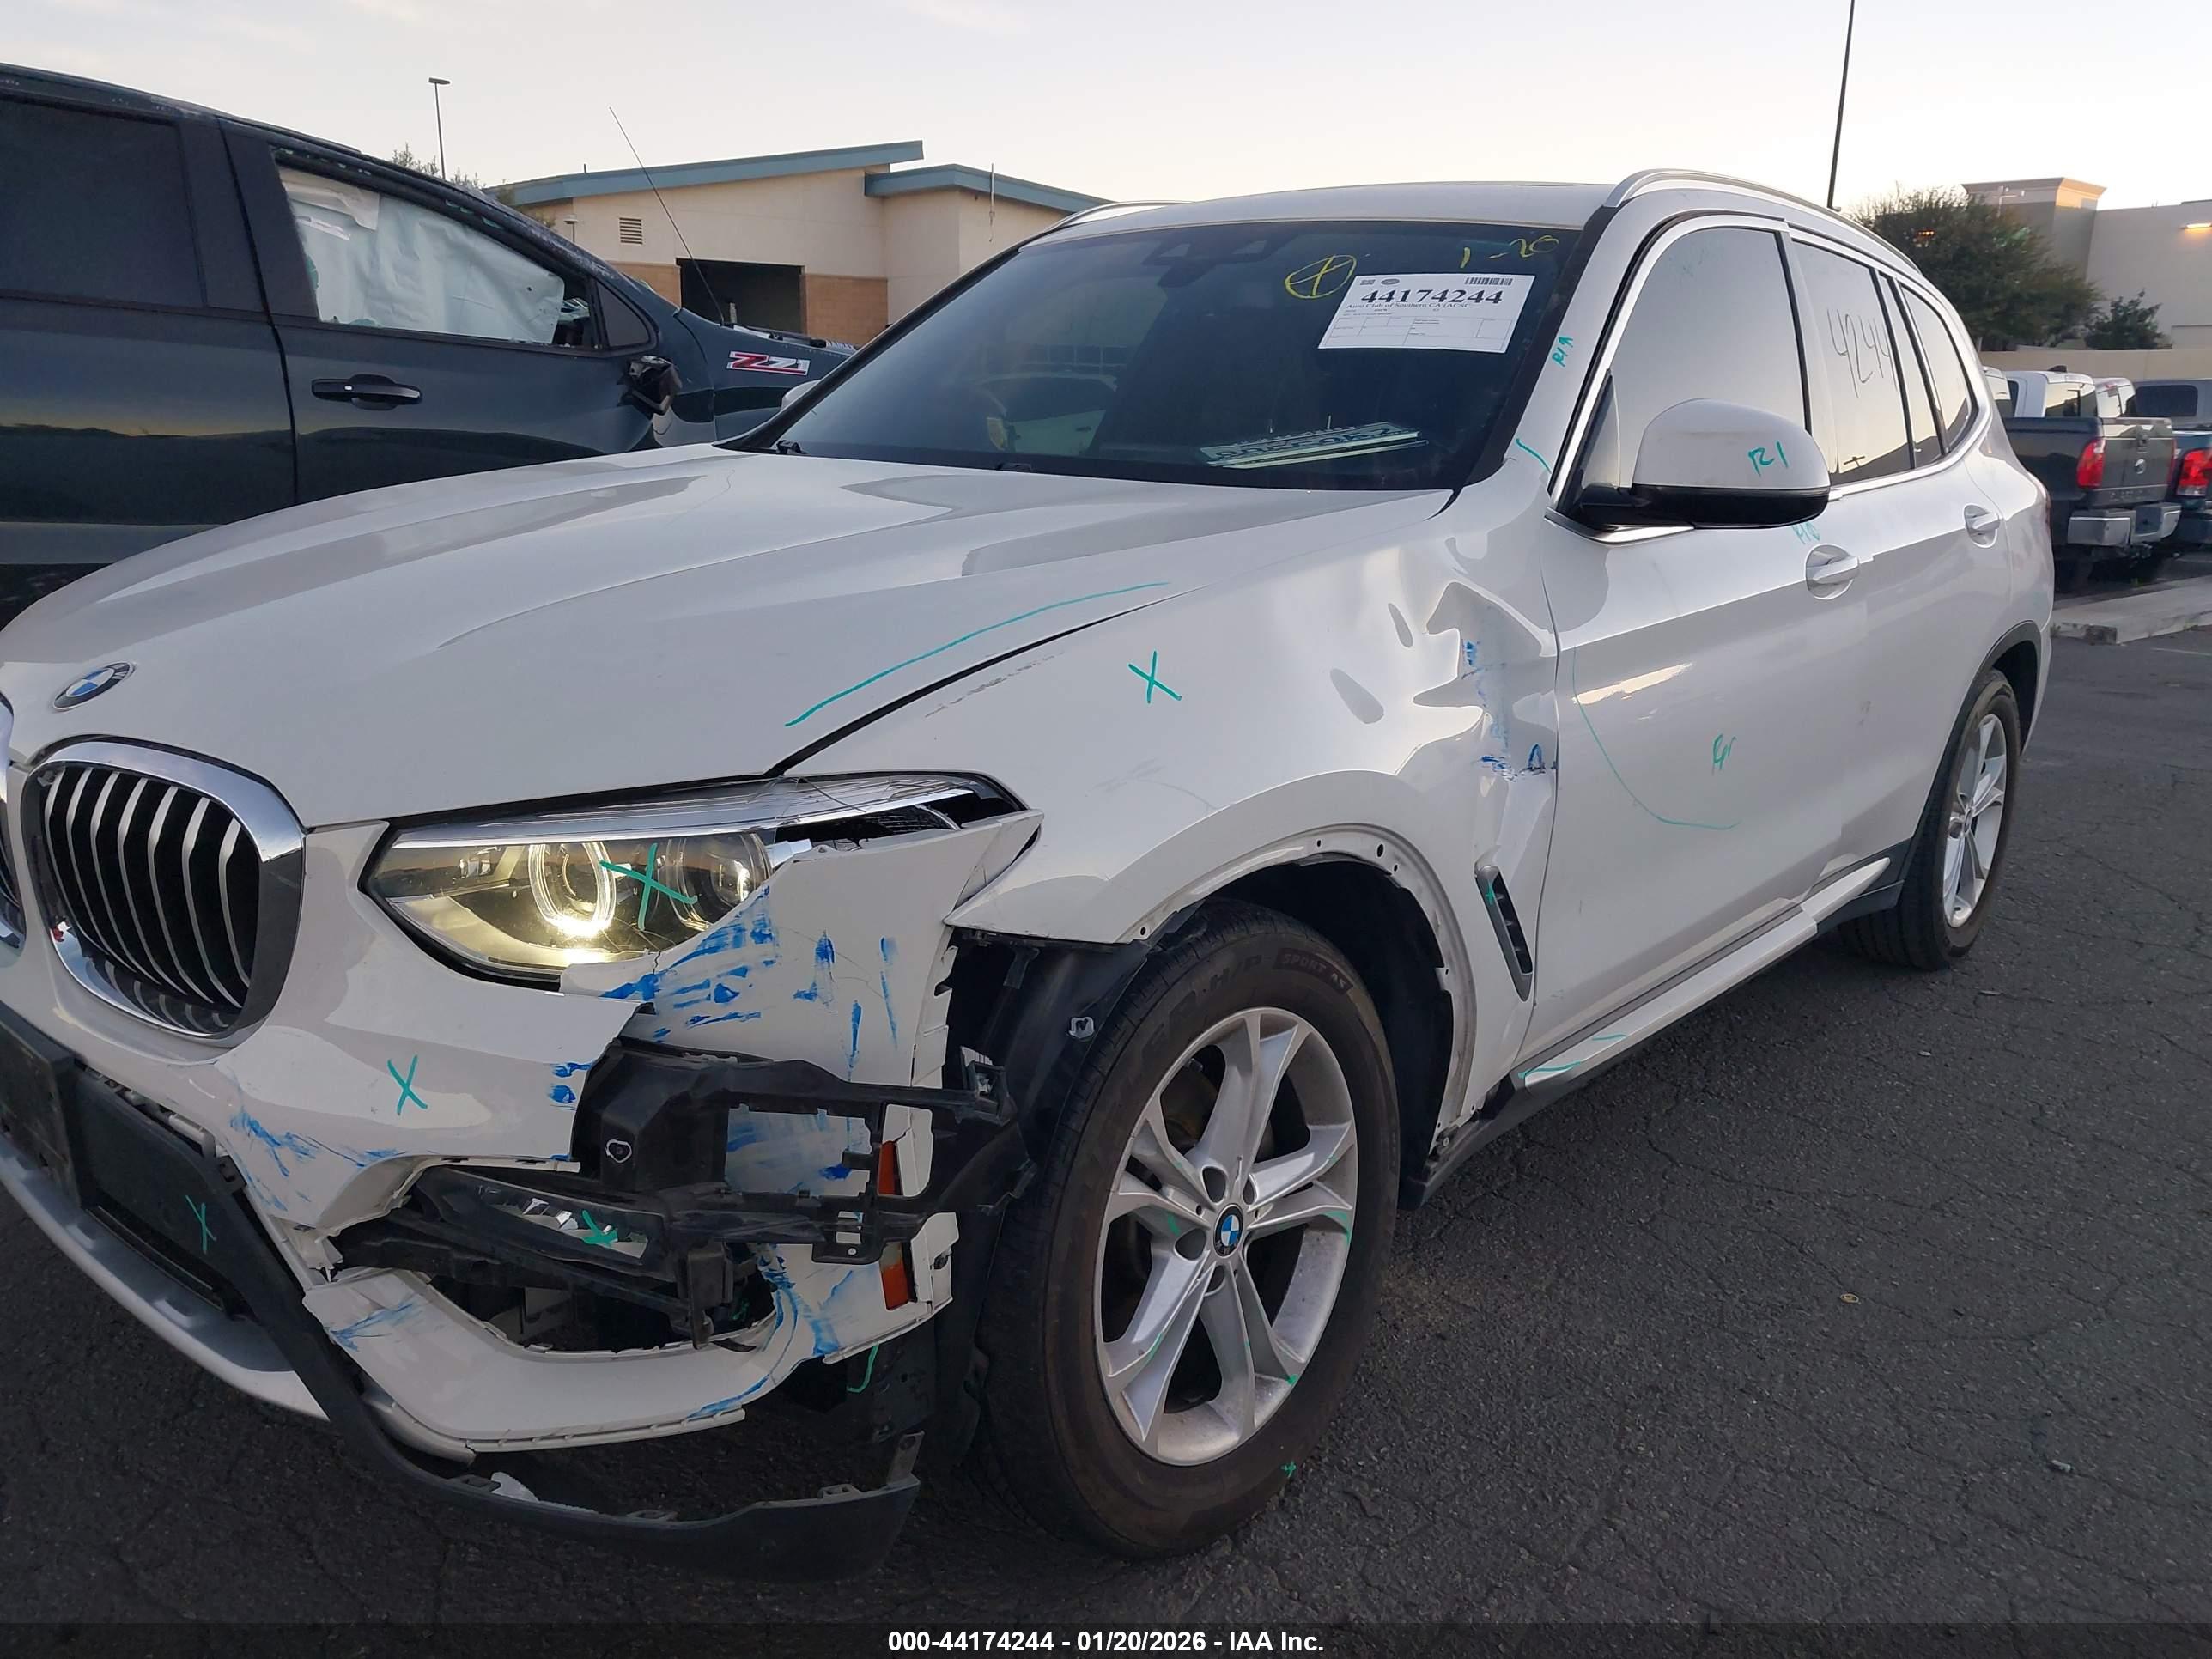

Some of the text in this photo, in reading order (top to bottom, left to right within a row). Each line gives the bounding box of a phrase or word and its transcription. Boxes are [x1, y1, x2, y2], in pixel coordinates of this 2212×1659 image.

[1361, 289, 1503, 304] 44174244
[726, 350, 810, 375] Z71
[1283, 952, 1327, 973] SPORT
